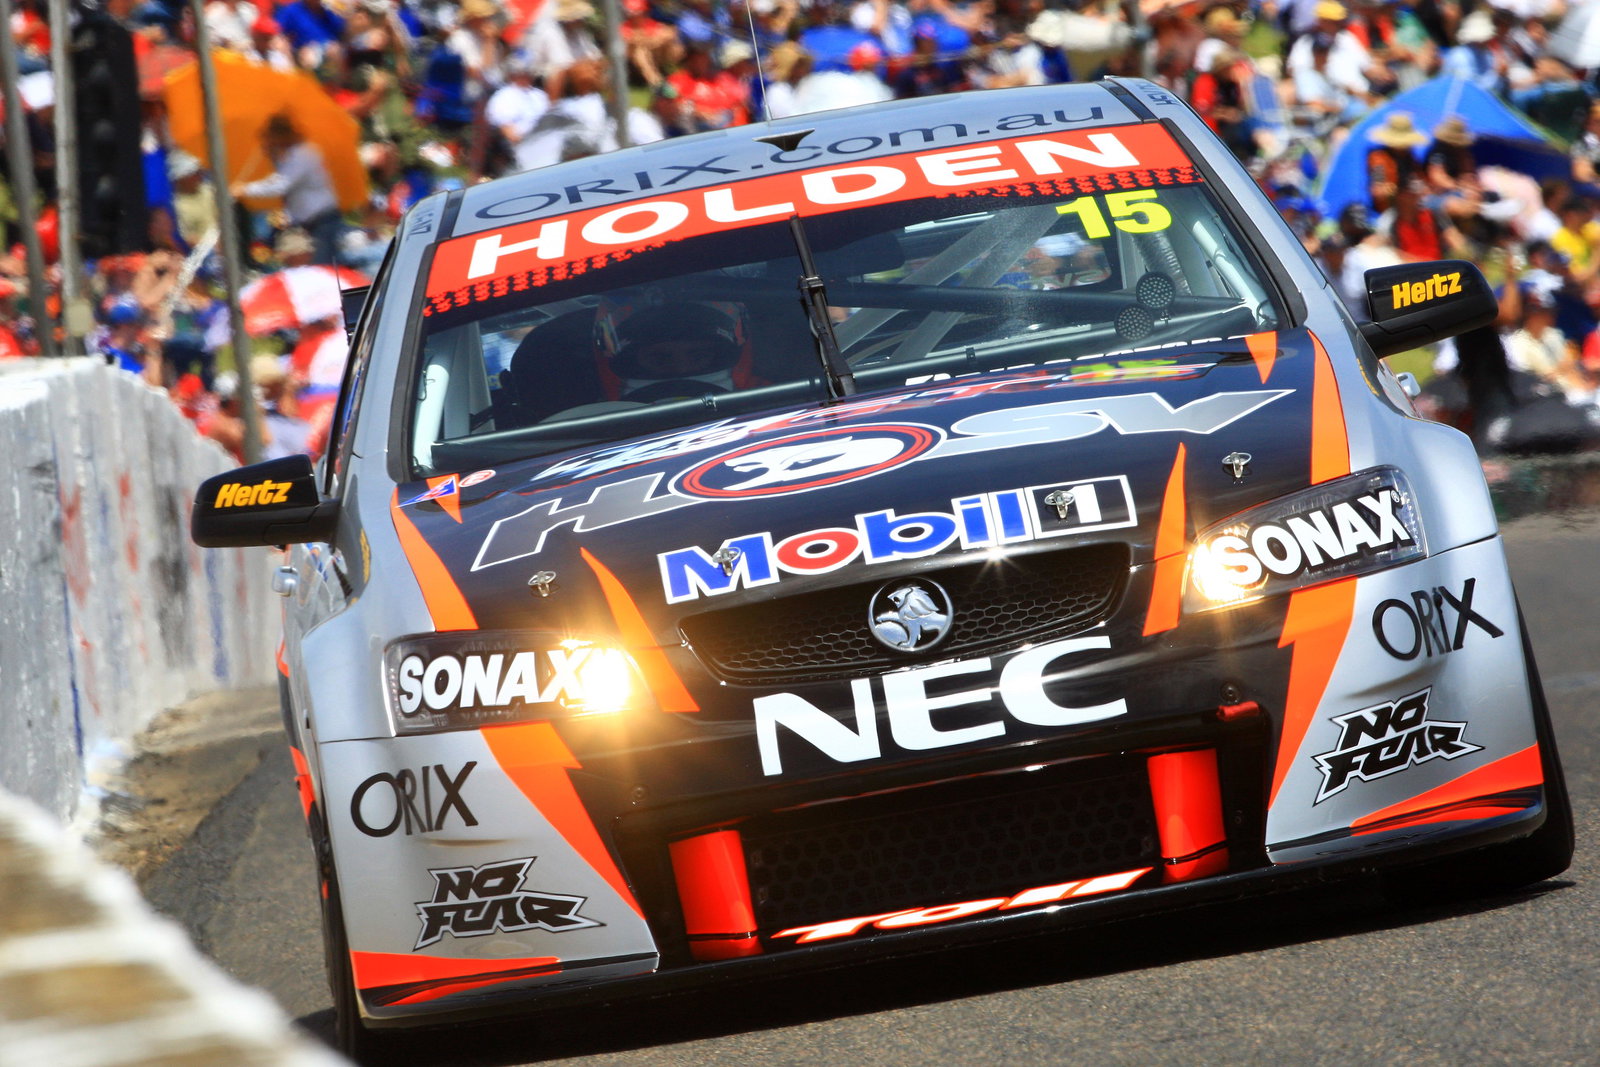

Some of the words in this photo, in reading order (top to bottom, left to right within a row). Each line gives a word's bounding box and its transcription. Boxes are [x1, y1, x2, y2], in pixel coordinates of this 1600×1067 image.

[474, 105, 1104, 219] ORIX.com.au
[466, 132, 1140, 280] HOLDEN
[1055, 188, 1172, 239] 15
[1391, 271, 1462, 310] Hertz
[213, 479, 293, 509] Hertz
[656, 486, 1034, 605] Mobil
[1208, 489, 1411, 587] SONAX
[1371, 577, 1504, 661] ORIX
[399, 649, 587, 714] SONAX
[752, 635, 1128, 776] NEC
[1331, 687, 1431, 750] NO
[350, 760, 479, 838] ORIX
[430, 857, 536, 903] NO
